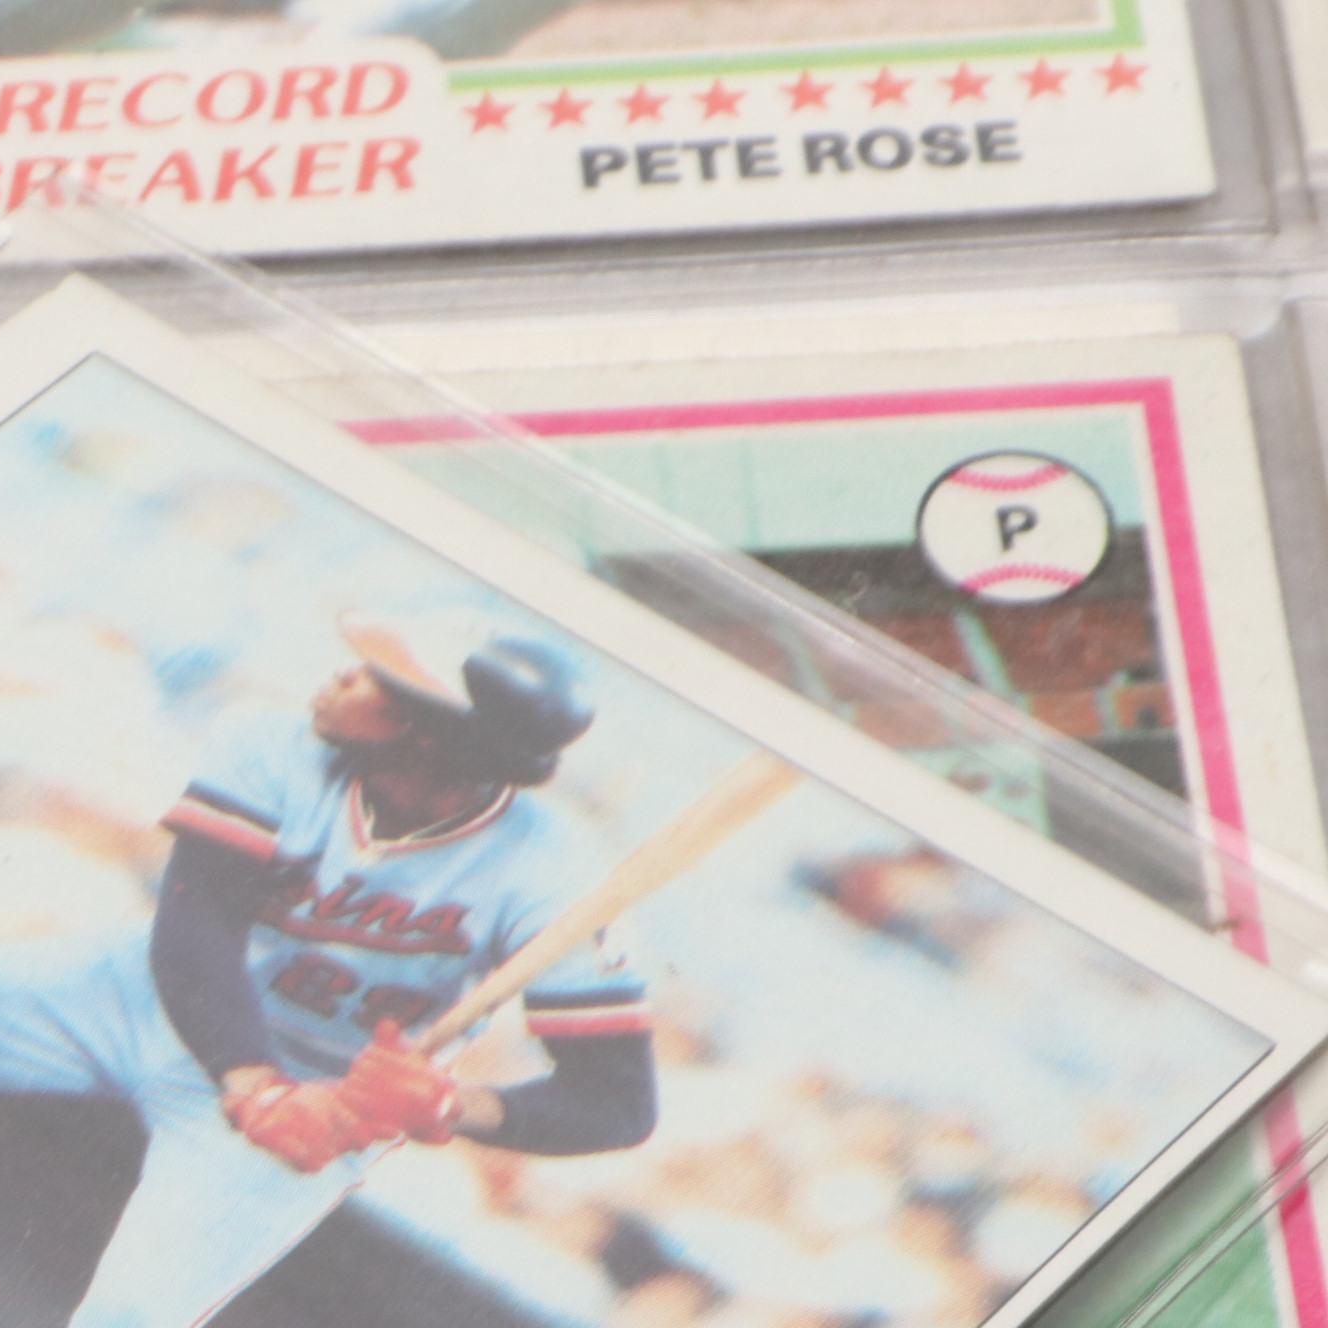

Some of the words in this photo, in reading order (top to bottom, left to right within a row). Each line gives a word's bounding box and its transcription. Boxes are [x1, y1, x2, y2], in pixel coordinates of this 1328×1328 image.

[578, 134, 784, 190] PETE
[802, 119, 1024, 175] ROSE
[996, 505, 1040, 553] P
